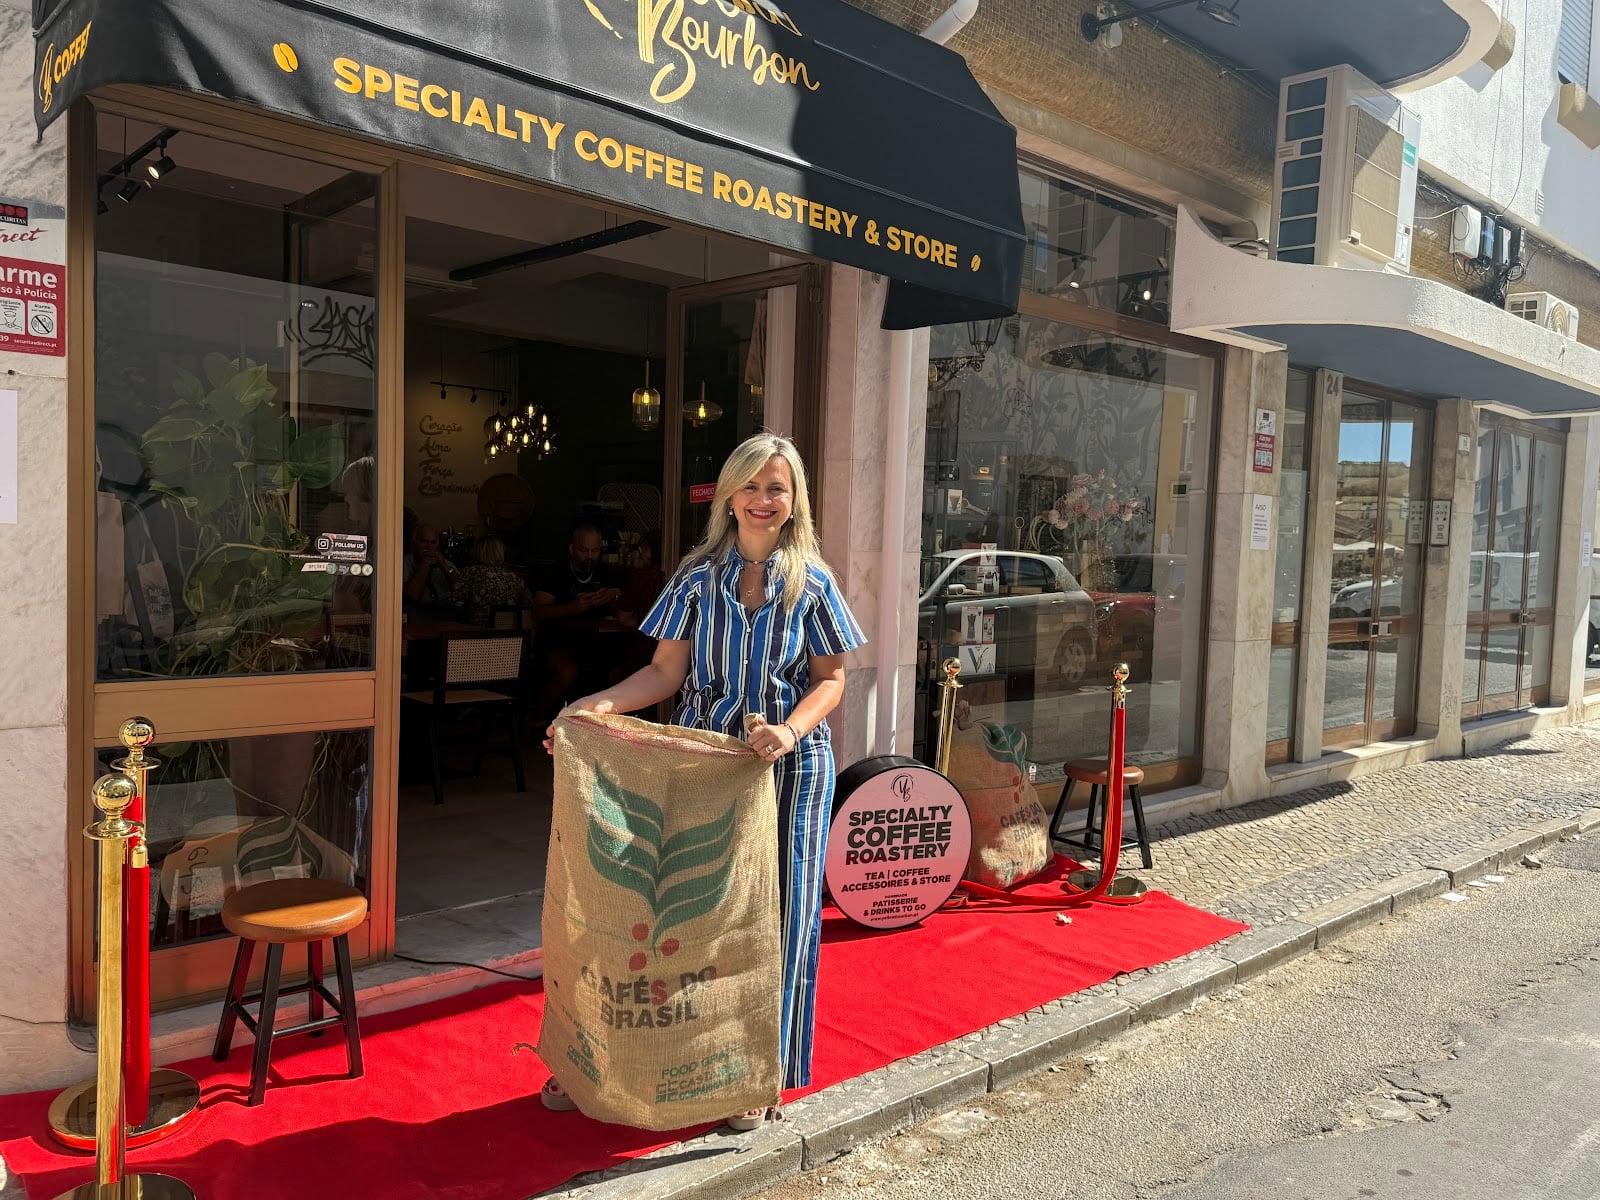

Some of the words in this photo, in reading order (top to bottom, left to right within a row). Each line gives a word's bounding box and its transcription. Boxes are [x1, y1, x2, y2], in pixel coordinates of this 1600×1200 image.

[637, 0, 820, 103] Bourbon
[333, 57, 565, 151] SPECIALTY
[574, 130, 704, 195] COFFEE
[713, 170, 858, 238] ROASTERY
[864, 219, 881, 247] &
[886, 224, 958, 269] STORE
[24, 287, 57, 300] Polícia
[1327, 374, 1339, 397] 24
[848, 805, 953, 827] SPECIALTY
[847, 821, 952, 849] COFFEE
[845, 842, 950, 866] ROASTERY
[841, 879, 910, 893] ACCESSOIRES
[911, 877, 918, 886] &
[919, 874, 951, 885] STORE
[865, 871, 885, 881] TEA
[892, 867, 930, 878] COFFEE
[863, 909, 870, 917] &
[870, 905, 901, 917] DRINKS
[902, 904, 913, 913] TO
[914, 903, 927, 912] GO
[872, 896, 919, 908] PATISSERIE
[581, 965, 668, 1006] CAFÉS
[680, 964, 718, 997] DO
[600, 1000, 698, 1030] BRASIL
[662, 1061, 698, 1080] FOOD
